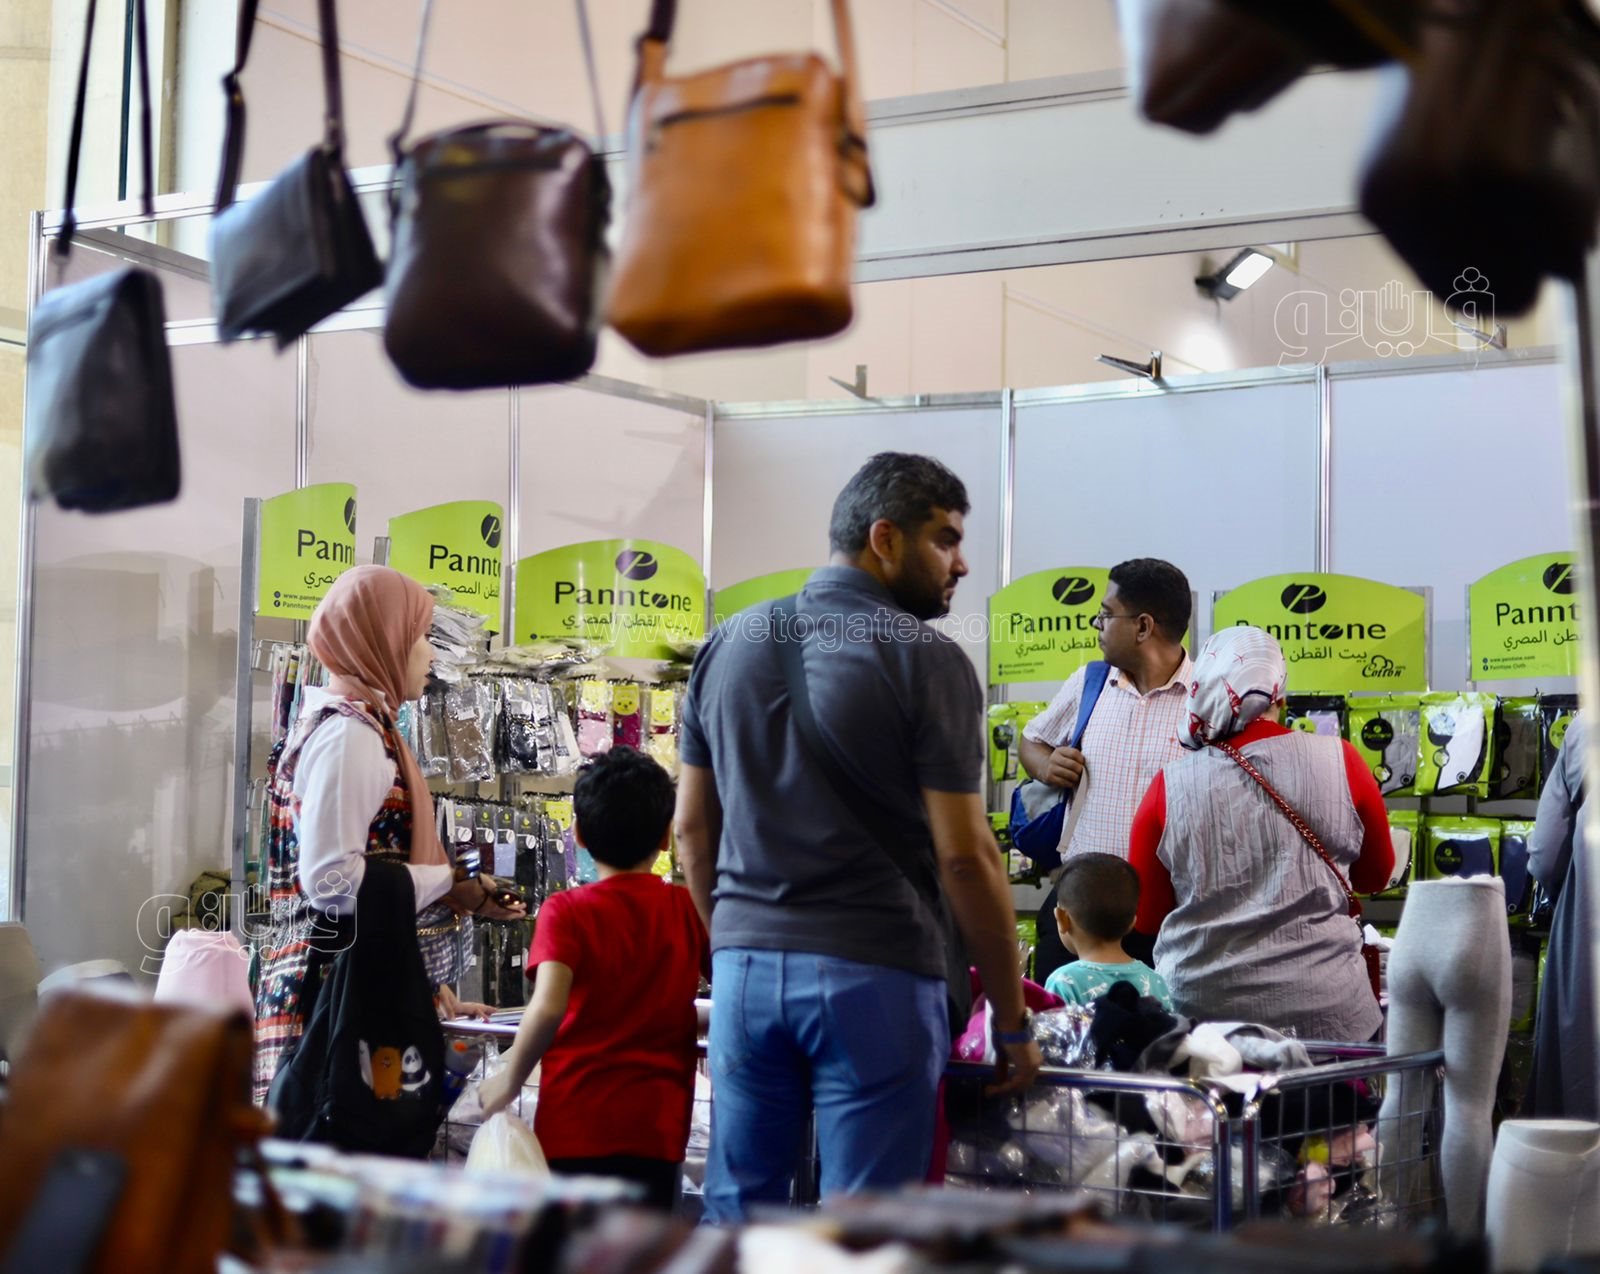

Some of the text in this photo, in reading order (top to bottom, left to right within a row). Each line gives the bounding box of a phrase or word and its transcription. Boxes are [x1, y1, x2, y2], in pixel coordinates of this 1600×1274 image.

[298, 529, 355, 566] Pann
[554, 581, 692, 612] Panntone
[1236, 619, 1387, 641] nntone
[1503, 629, 1548, 651] المصري
[1015, 636, 1096, 658] لقطن المصري
[1289, 646, 1332, 662] القطن
[1338, 650, 1367, 663] بيت
